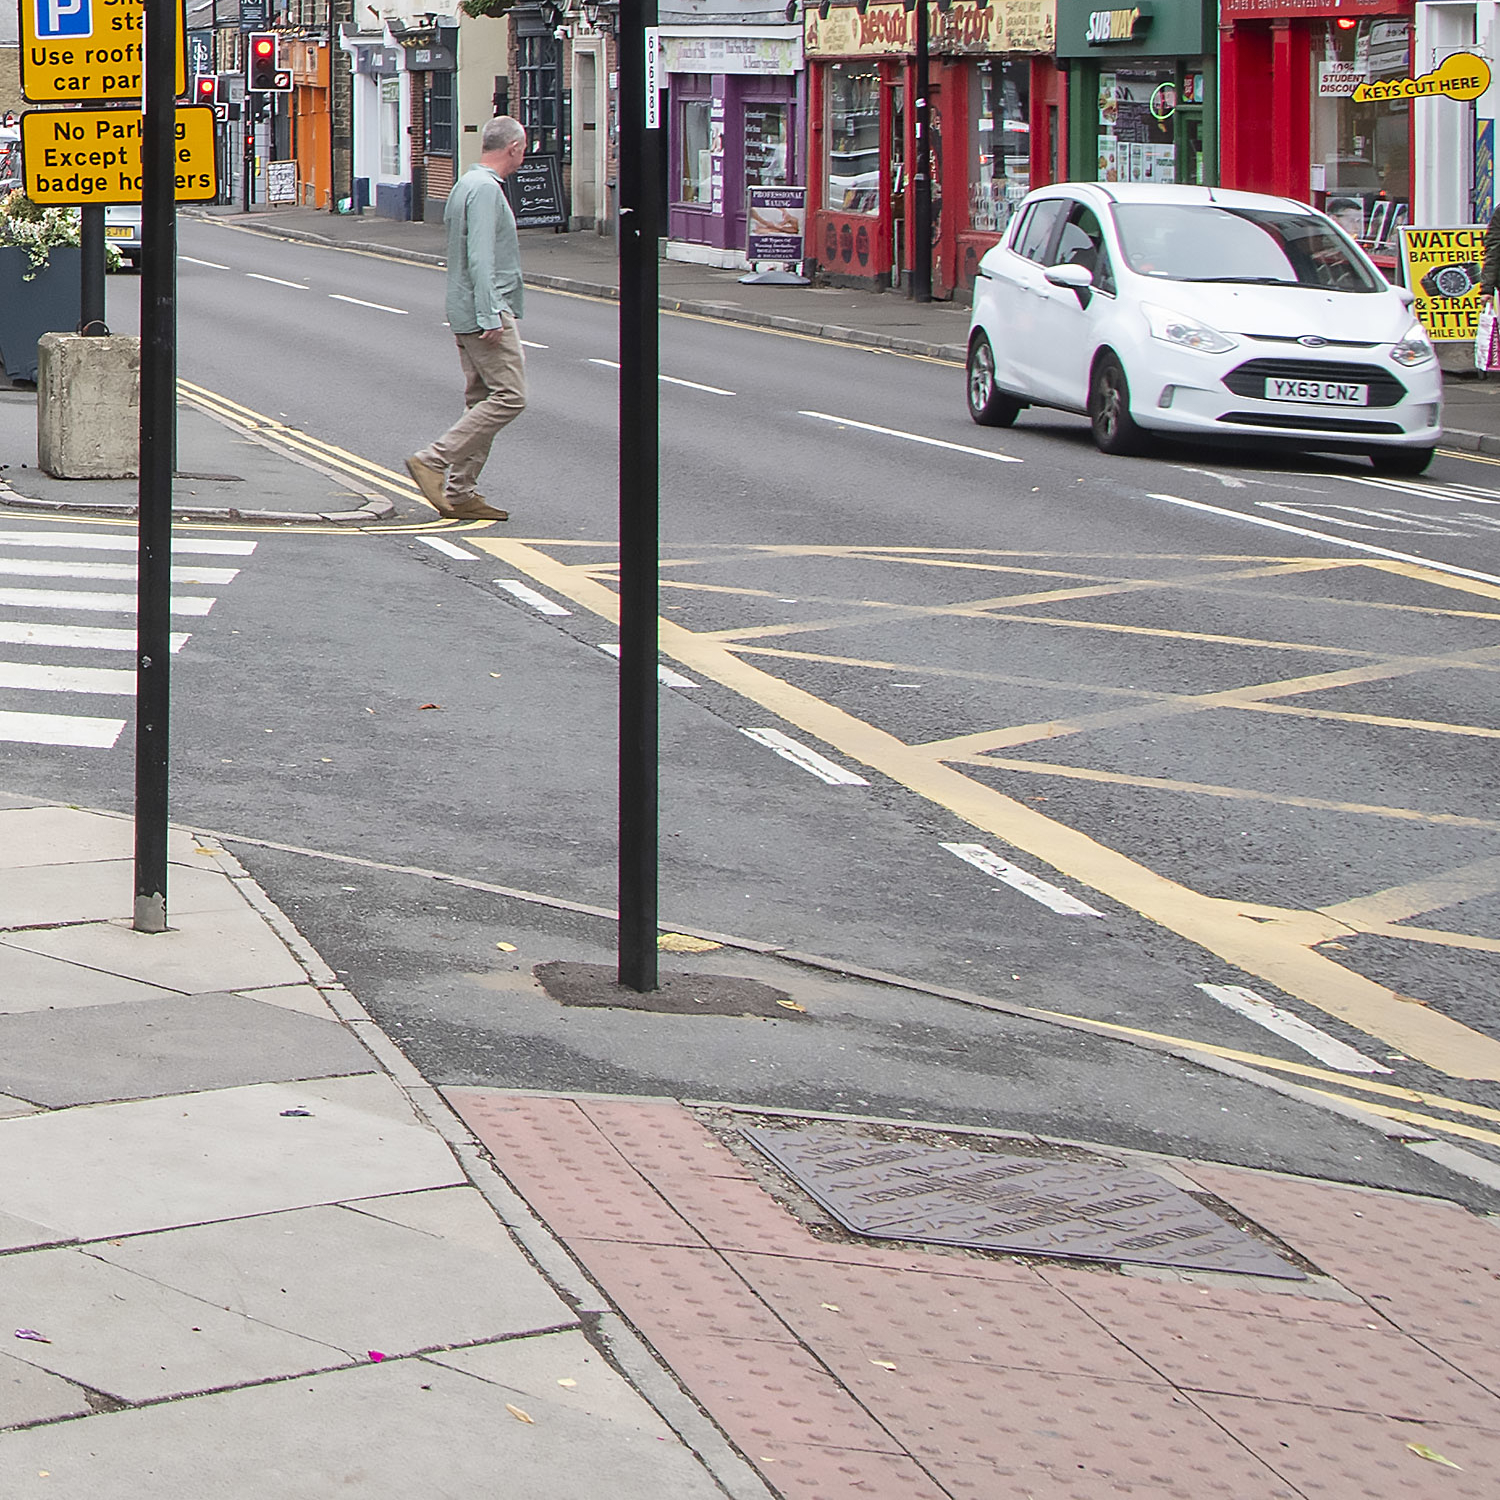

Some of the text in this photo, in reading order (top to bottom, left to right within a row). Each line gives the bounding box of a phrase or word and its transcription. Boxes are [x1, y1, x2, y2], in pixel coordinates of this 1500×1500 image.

[1227, 0, 1249, 11] LADIES
[111, 12, 144, 31] sta
[1086, 6, 1141, 42] SUBWAY
[31, 44, 144, 66] Use rooft
[1332, 62, 1355, 73] 10%
[53, 74, 141, 93] car par
[1322, 74, 1366, 83] STUDENT
[1363, 76, 1480, 100] KEYS CUT HERE
[54, 122, 85, 141] No
[44, 147, 128, 169] Except
[36, 173, 108, 195] badge
[752, 190, 803, 199] PROFESSIONAL
[764, 200, 791, 208] WAXING
[1407, 231, 1484, 249] WATCH
[1414, 298, 1427, 310] &
[1426, 328, 1455, 338] HILE
[1457, 329, 1466, 338] U
[1274, 380, 1359, 401] YX63 CNZ
